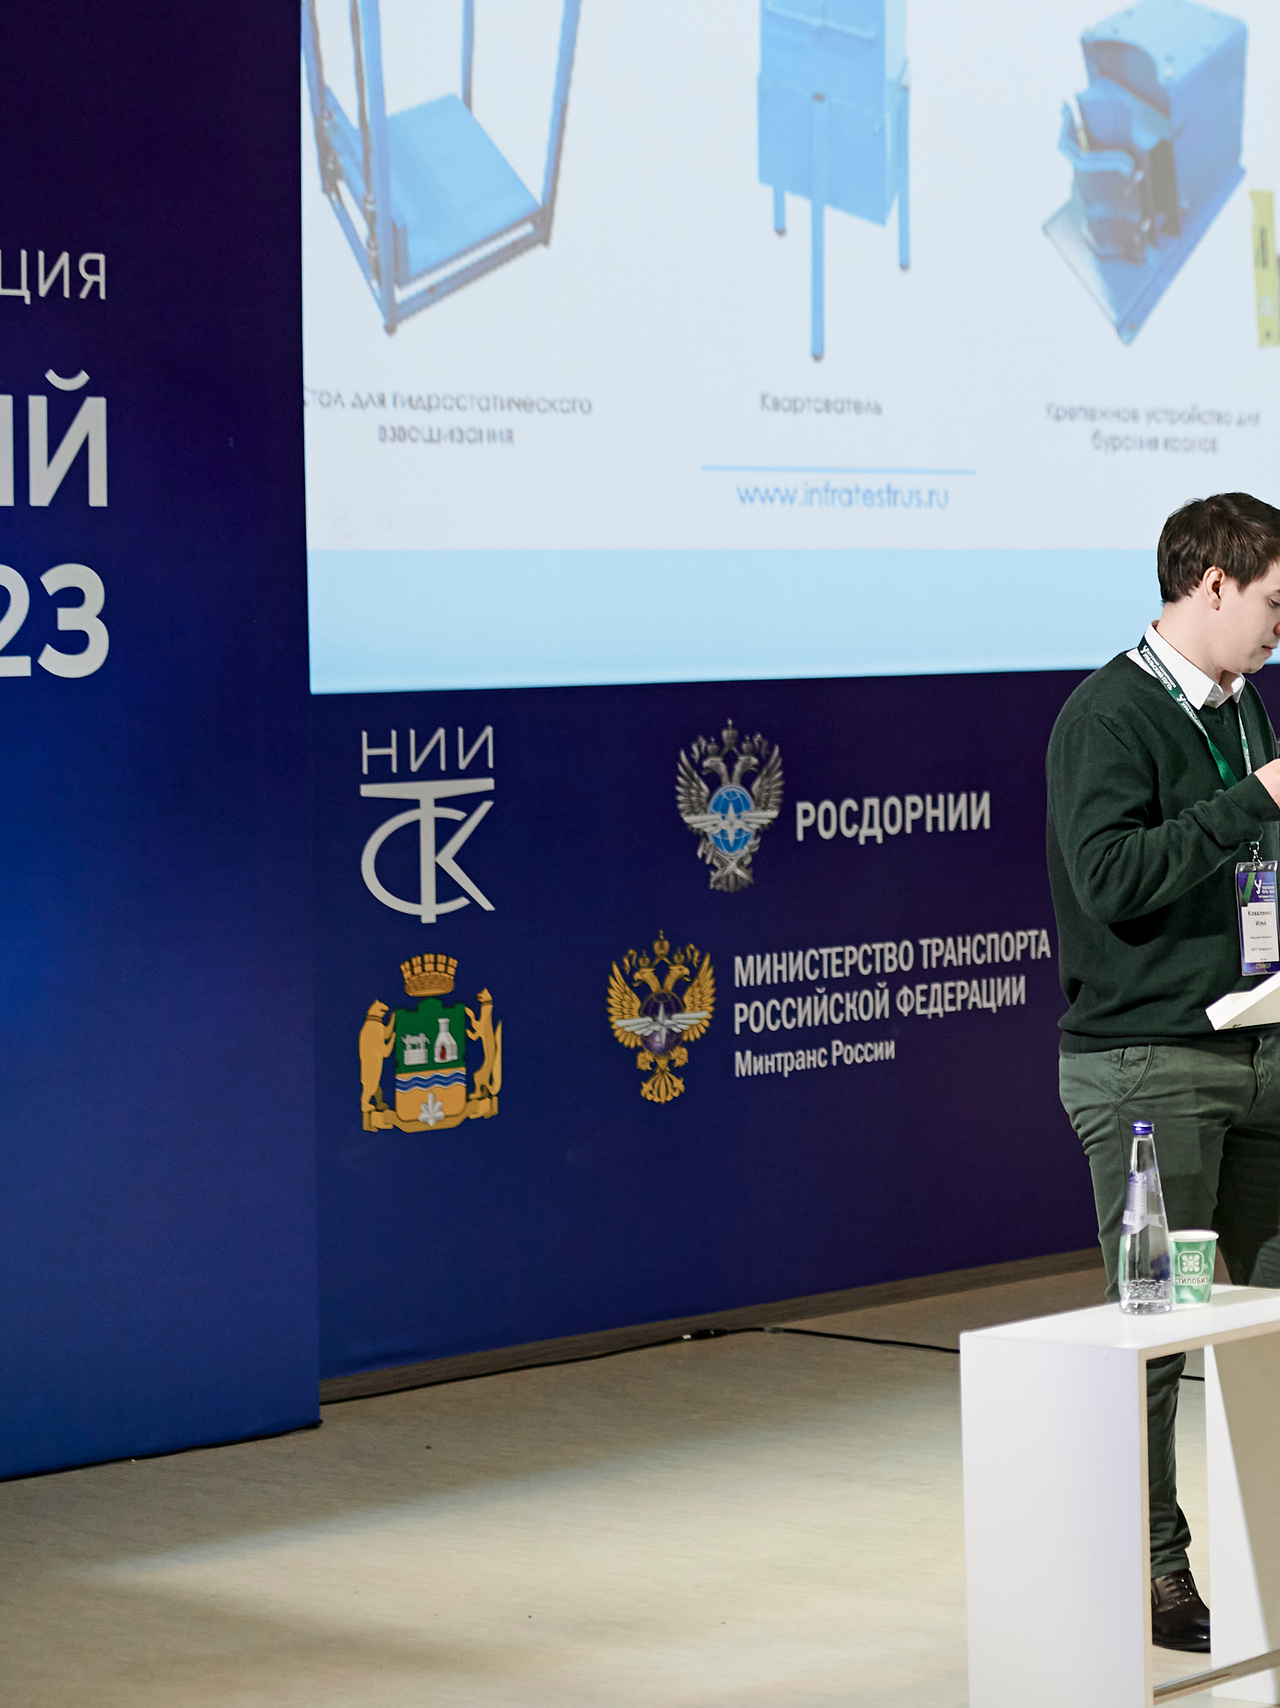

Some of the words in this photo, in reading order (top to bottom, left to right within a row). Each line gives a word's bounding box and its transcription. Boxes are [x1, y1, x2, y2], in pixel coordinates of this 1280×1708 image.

[760, 391, 883, 417] Квартователь
[1046, 402, 1140, 424] Крепежное
[1144, 404, 1233, 428] устройство
[0, 368, 109, 507] Й
[735, 479, 949, 510] www.infratestrus.ru
[361, 725, 495, 775] НИИ
[795, 791, 991, 844] РОСДОРНИИ
[734, 941, 914, 988] МИНИСТЕРСТВО
[920, 929, 1051, 970] ТРАНСПОРТА
[734, 983, 889, 1035] РОССИЙСКОЙ
[896, 975, 1026, 1019] ФЕДЕРАЦИИ
[734, 1048, 828, 1078] Минтранс
[831, 1040, 896, 1067] России
[1174, 1276, 1209, 1285] СТИЛОБИТ
